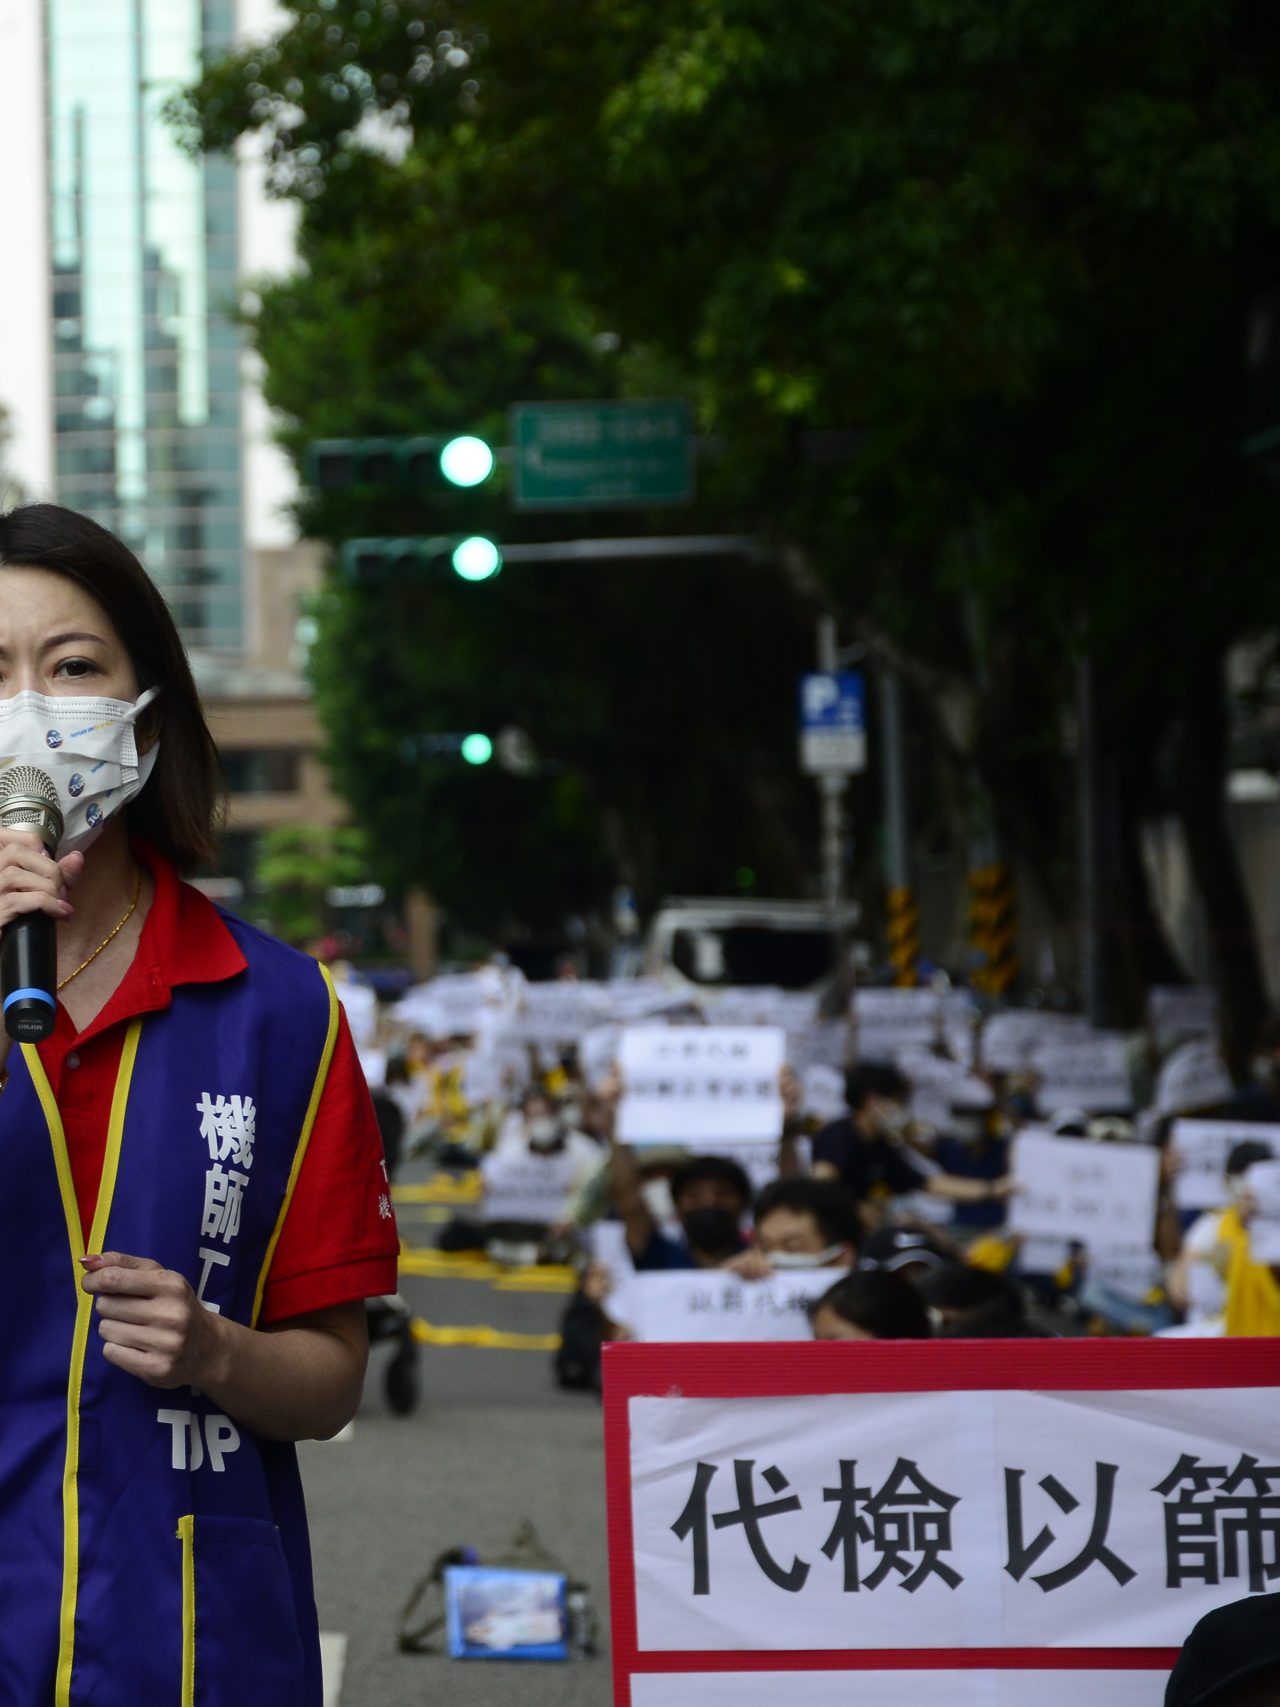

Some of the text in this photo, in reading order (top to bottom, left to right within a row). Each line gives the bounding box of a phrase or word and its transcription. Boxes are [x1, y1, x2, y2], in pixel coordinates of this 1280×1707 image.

[190, 1091, 257, 1397] 機師工
[669, 1452, 1280, 1597] 代檢以篩
